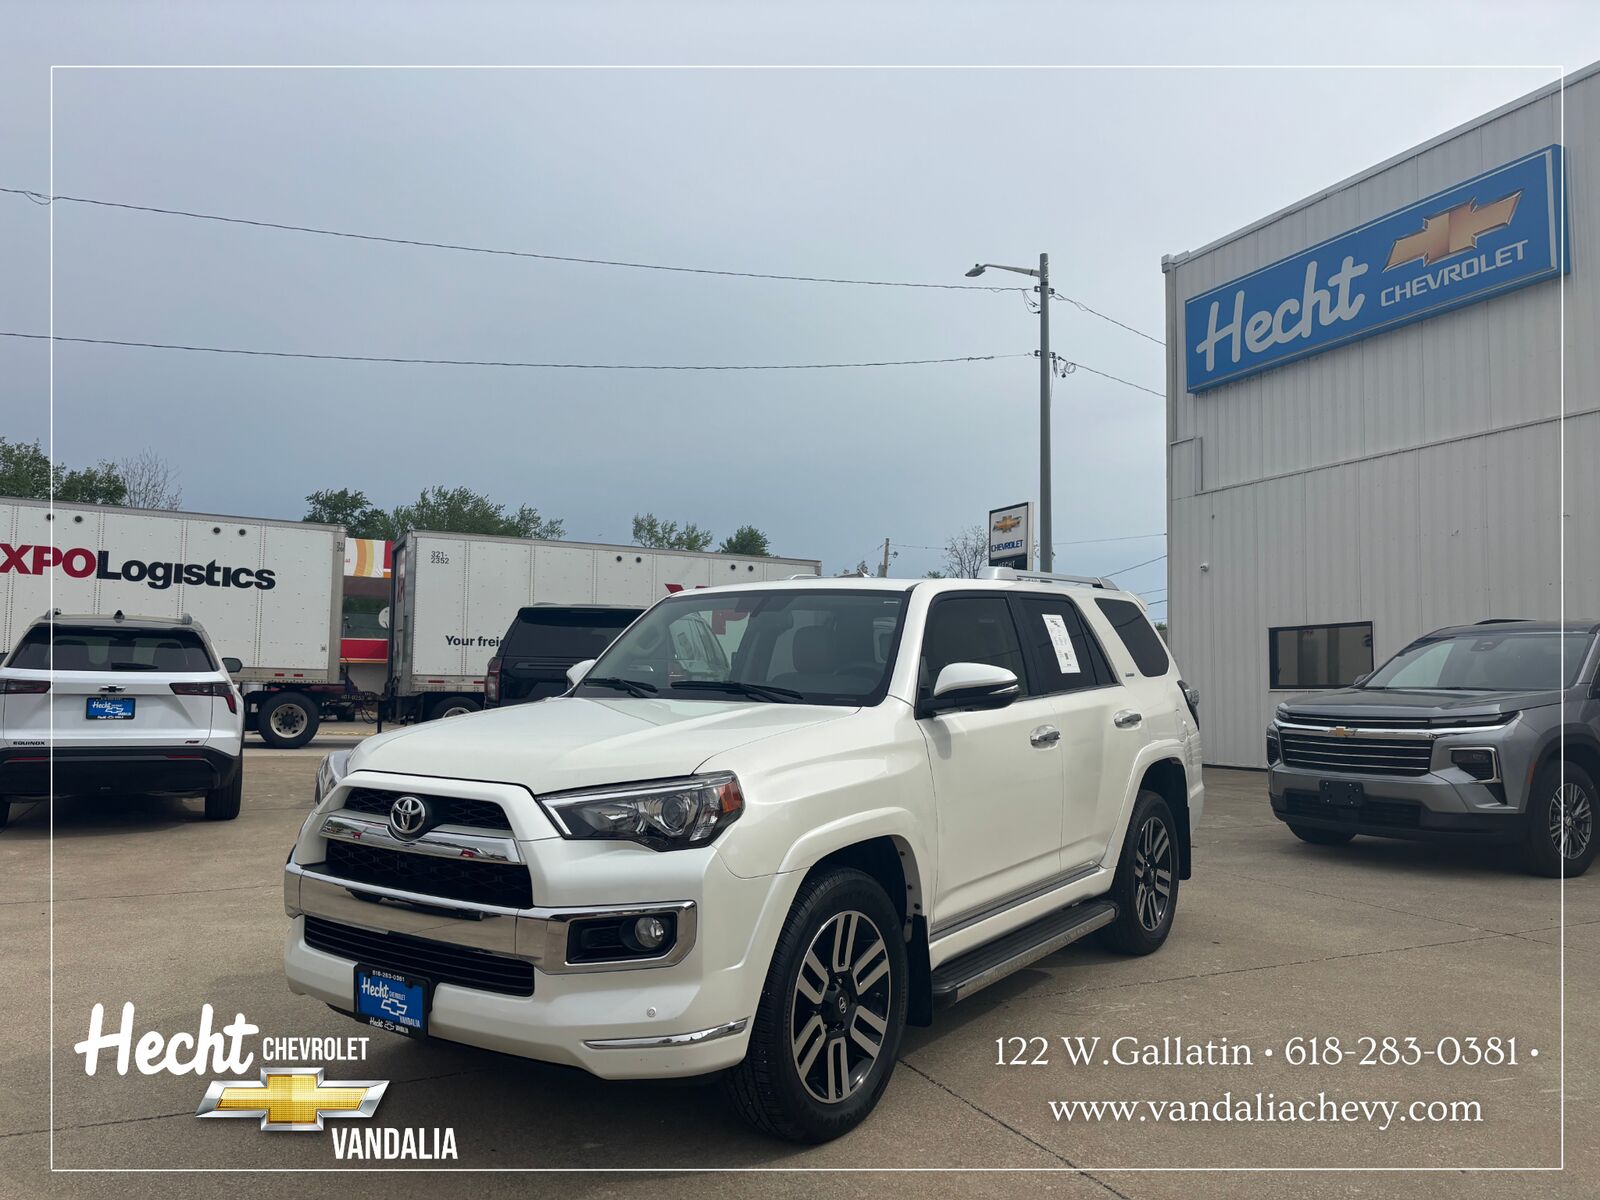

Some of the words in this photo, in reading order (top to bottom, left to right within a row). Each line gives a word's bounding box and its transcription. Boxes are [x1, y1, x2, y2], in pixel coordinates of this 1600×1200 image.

[1196, 255, 1368, 371] Hecht
[1381, 240, 1528, 307] CHEVROLET
[991, 539, 1023, 552] CHEVROLET
[445, 635, 475, 646] Your
[477, 636, 501, 647] frei
[361, 976, 389, 999] Hecht
[369, 1017, 383, 1028] Hecht
